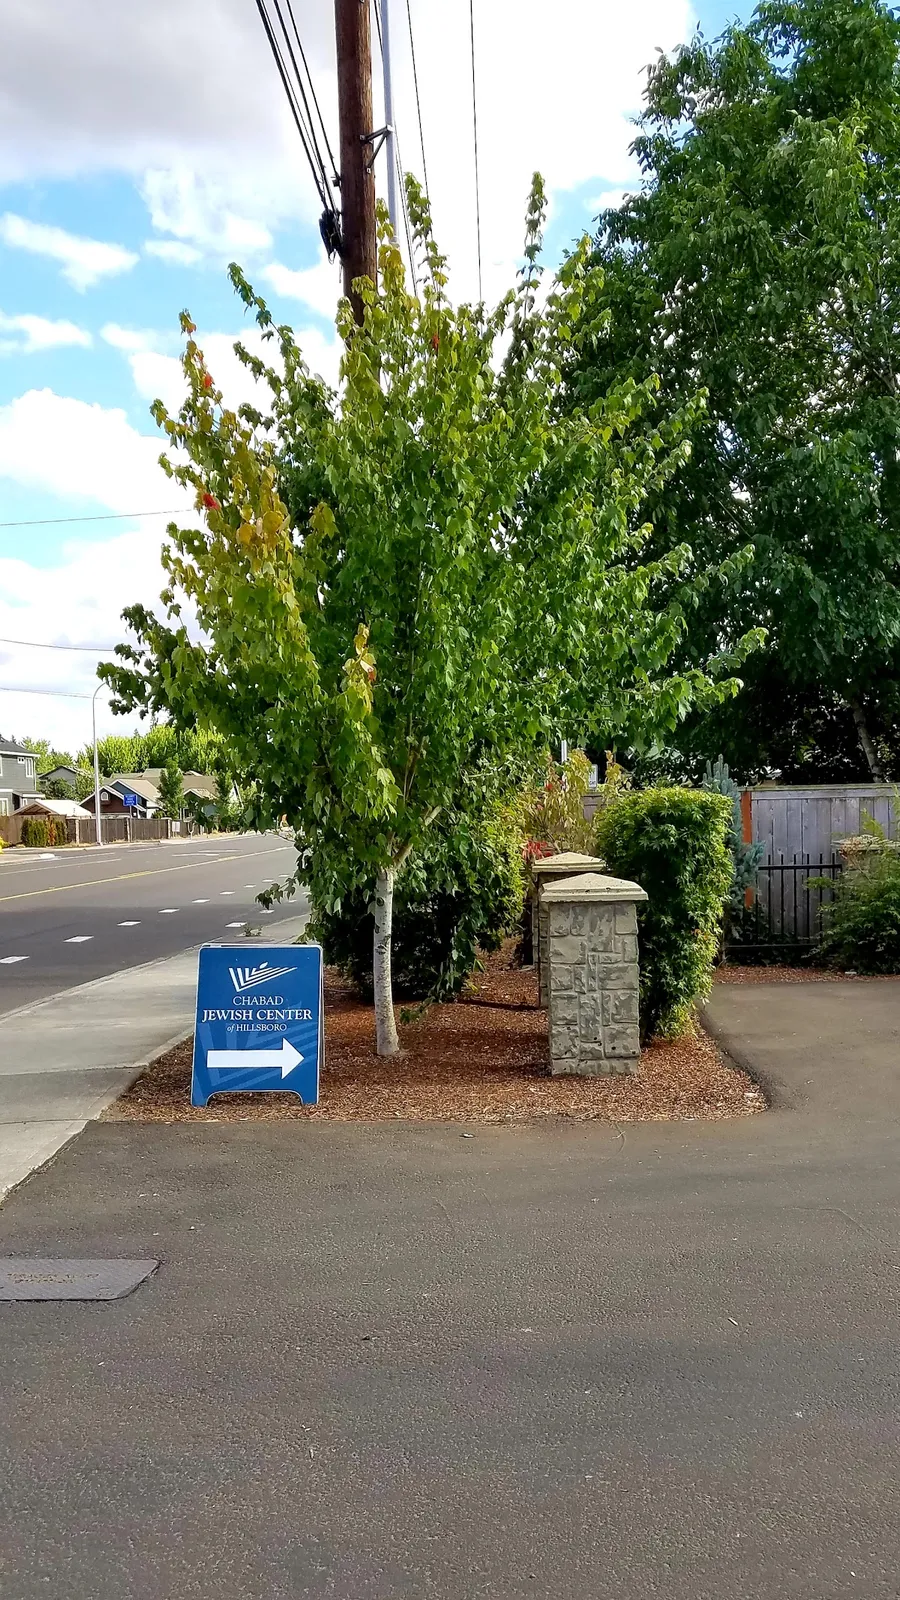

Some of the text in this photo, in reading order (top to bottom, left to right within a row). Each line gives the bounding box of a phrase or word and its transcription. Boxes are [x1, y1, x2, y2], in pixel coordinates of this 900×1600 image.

[232, 995, 284, 1006] CHABAD
[202, 1009, 313, 1022] JEWISH CENTER
[226, 1023, 287, 1033] of HILLSBORO
